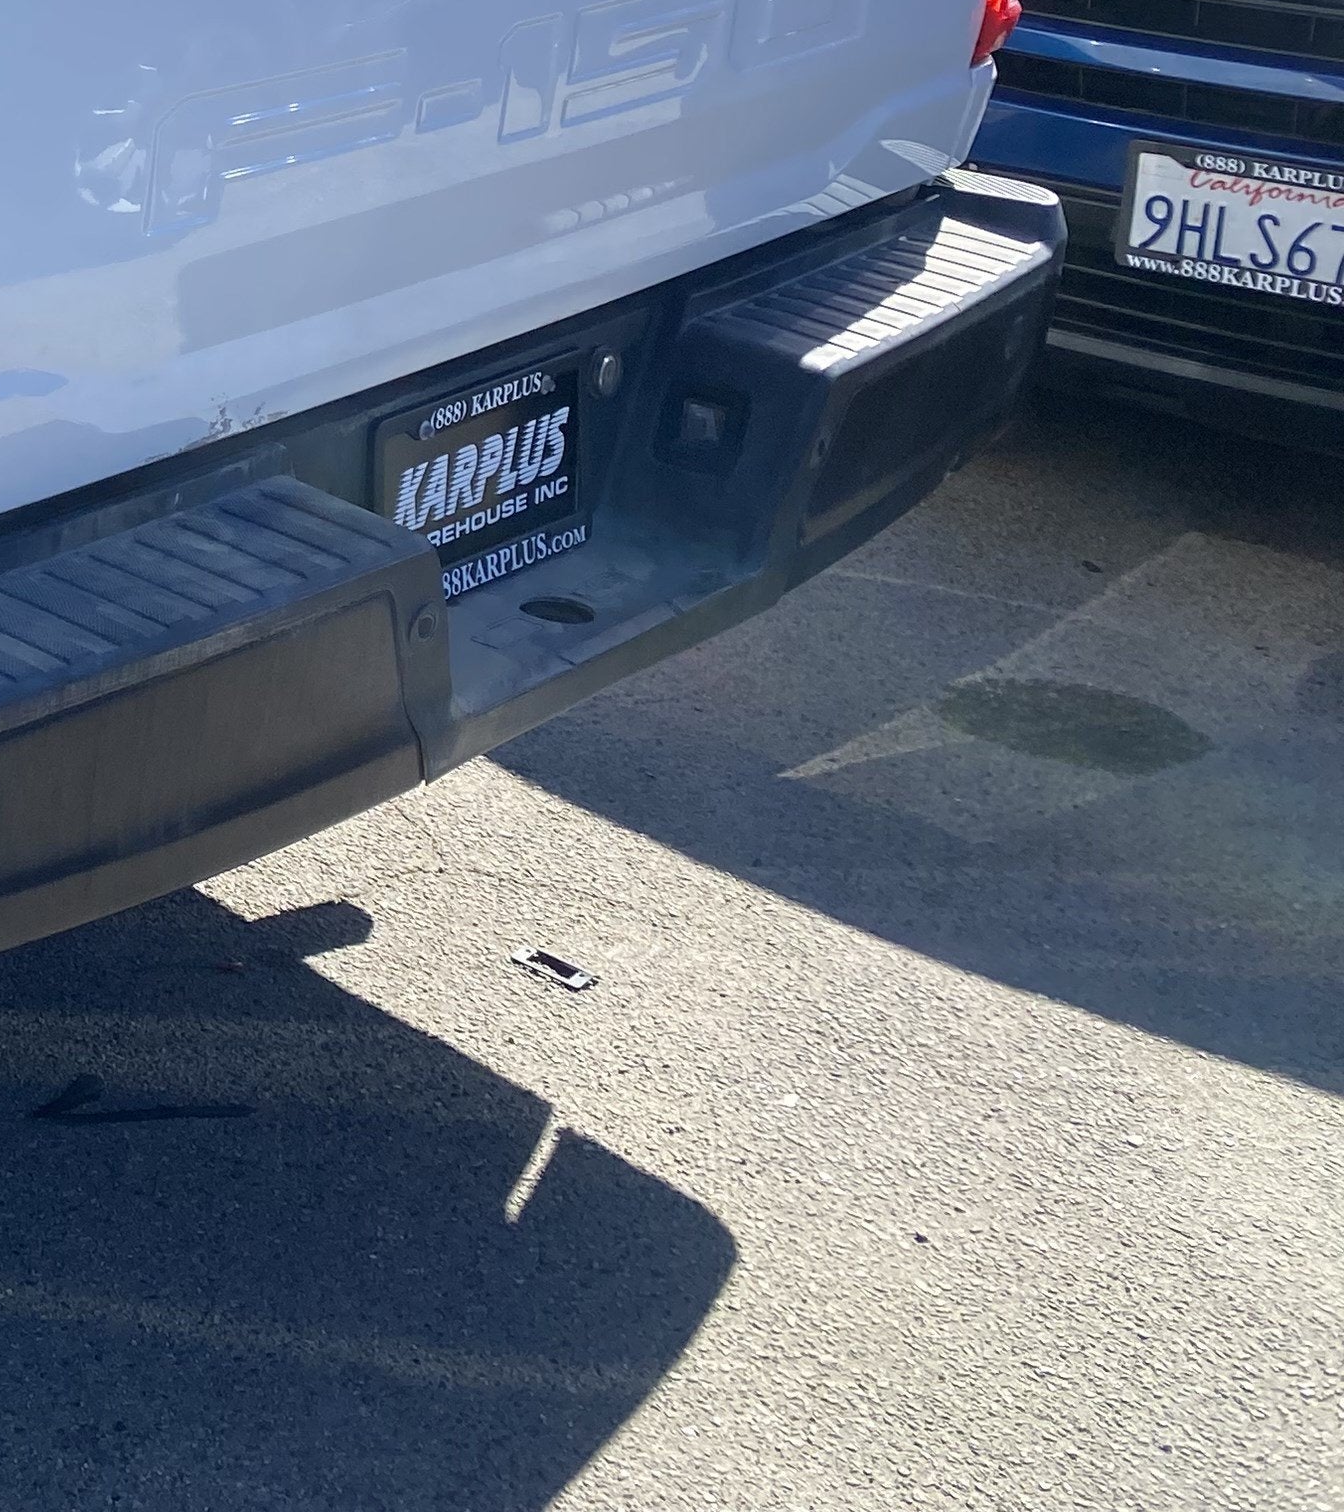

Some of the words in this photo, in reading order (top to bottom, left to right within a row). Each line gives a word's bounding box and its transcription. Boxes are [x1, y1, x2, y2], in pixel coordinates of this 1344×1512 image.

[1196, 153, 1246, 174] (888)
[430, 399, 468, 431] (888)
[470, 371, 543, 417] KARPLUS
[393, 406, 570, 531] KARPLUS
[534, 476, 569, 505] INC
